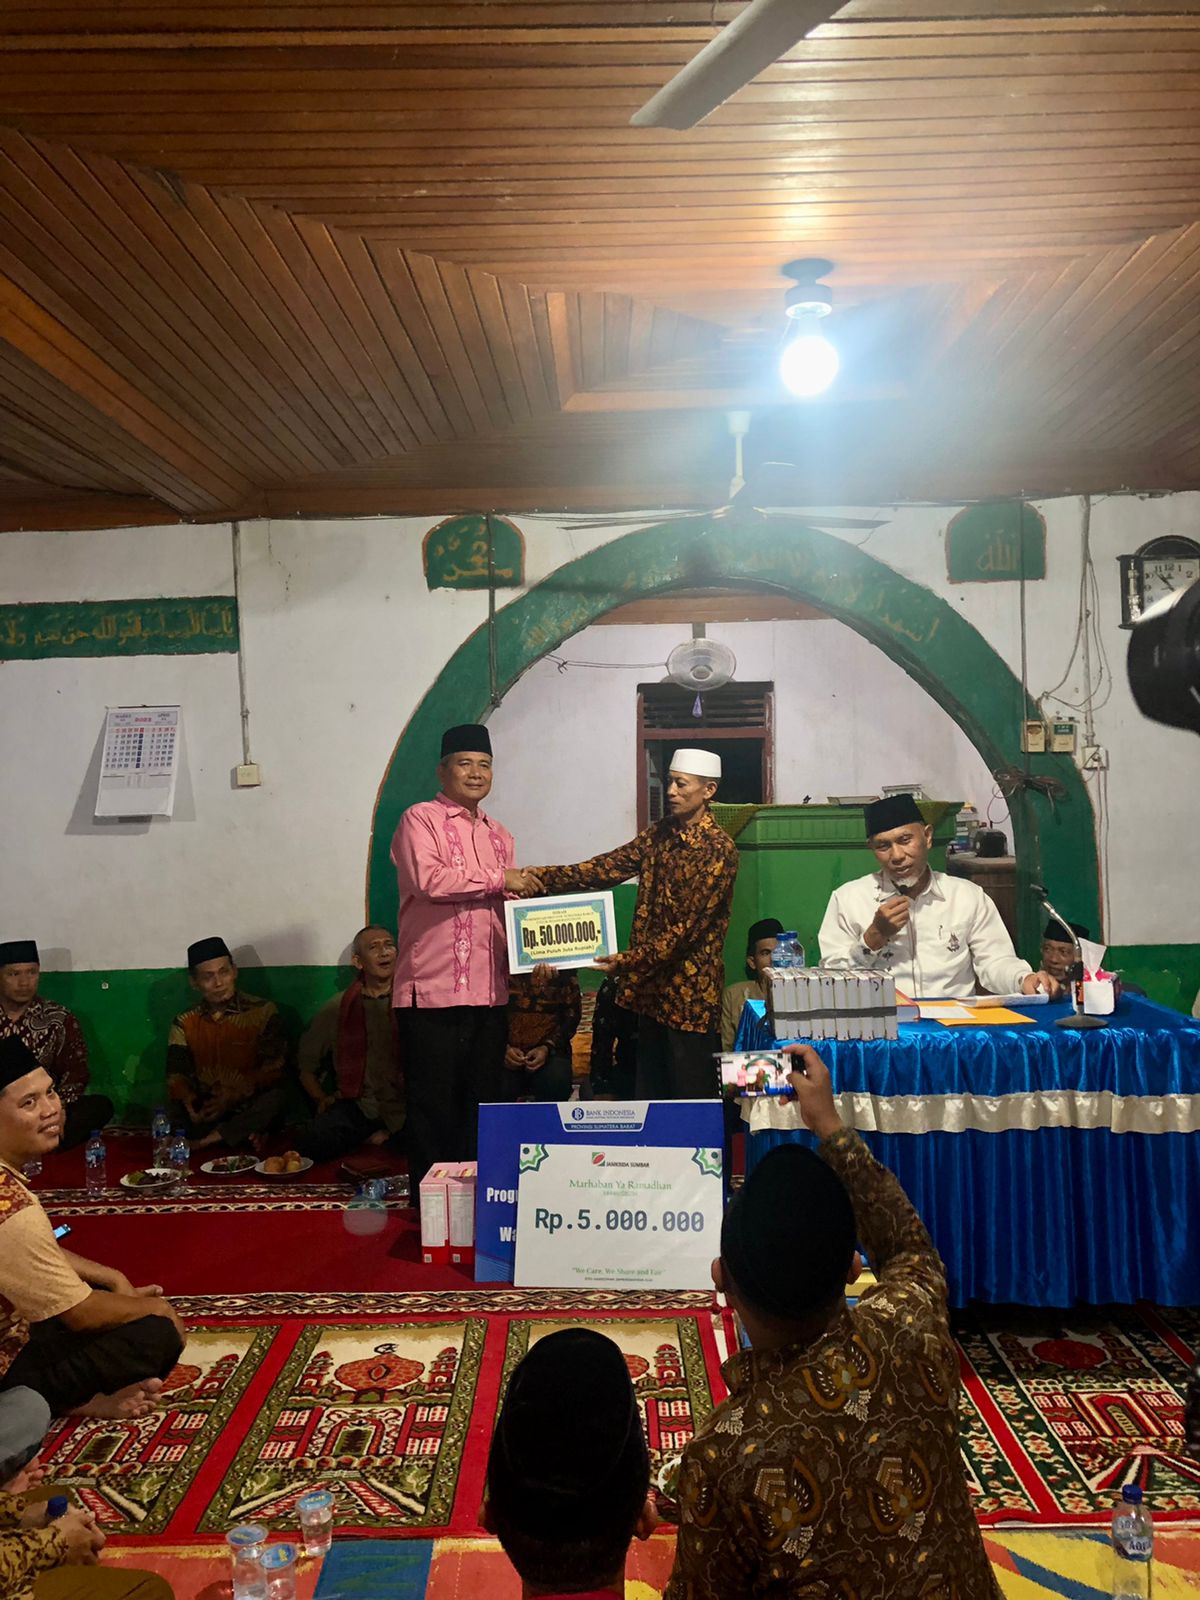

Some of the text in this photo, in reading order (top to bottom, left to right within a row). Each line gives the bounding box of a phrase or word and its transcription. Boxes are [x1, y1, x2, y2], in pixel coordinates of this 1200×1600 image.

[1165, 562, 1175, 571] 12
[1185, 570, 1193, 578] 2
[522, 927, 539, 949] Rp.
[569, 1179, 673, 1190] Marhaban Ya Ramadhan
[535, 1208, 705, 1234] Rp.5.000.000
